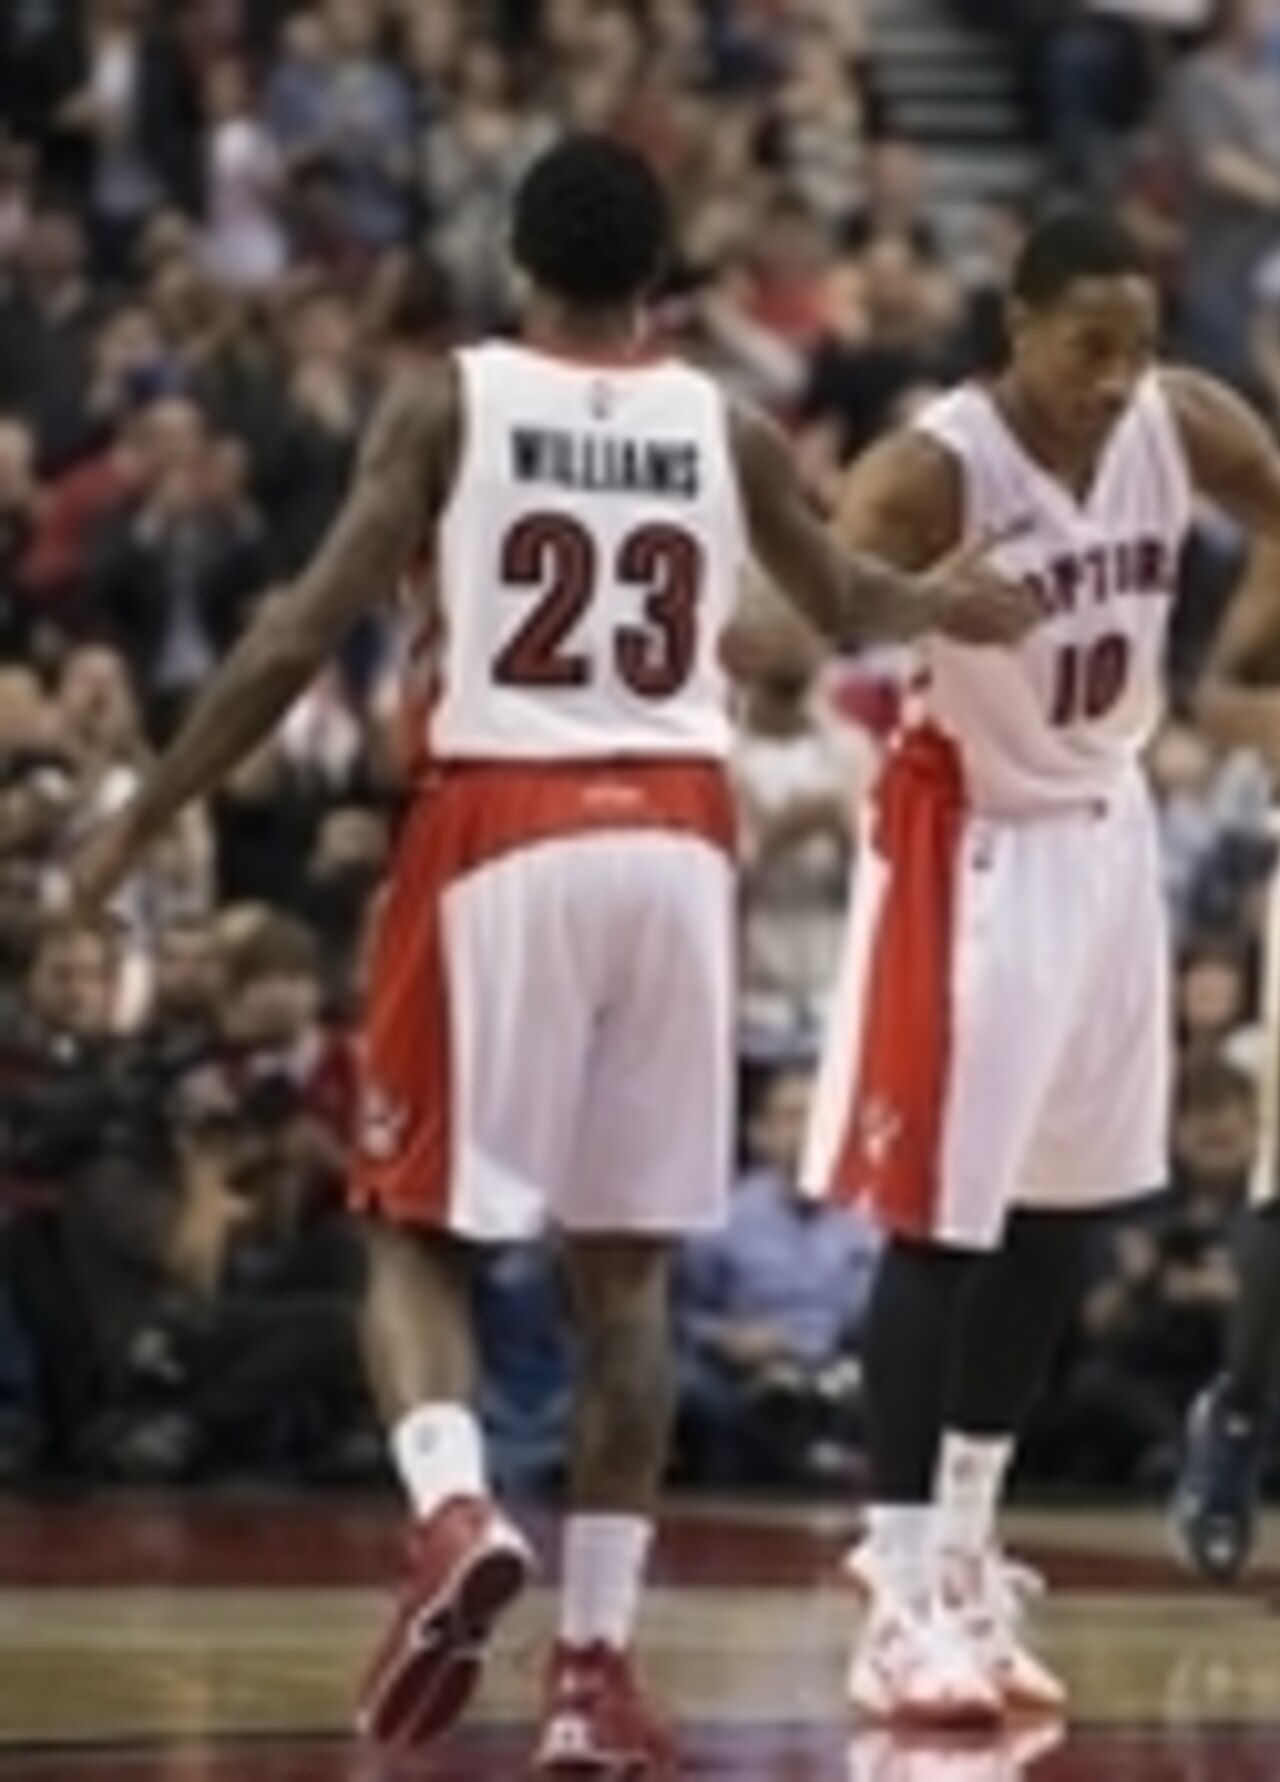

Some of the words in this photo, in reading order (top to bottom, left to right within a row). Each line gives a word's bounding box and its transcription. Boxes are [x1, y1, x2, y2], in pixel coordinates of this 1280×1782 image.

[511, 428, 698, 500] WILLIAMS
[492, 510, 703, 700] 23
[1051, 634, 1130, 728] 10
